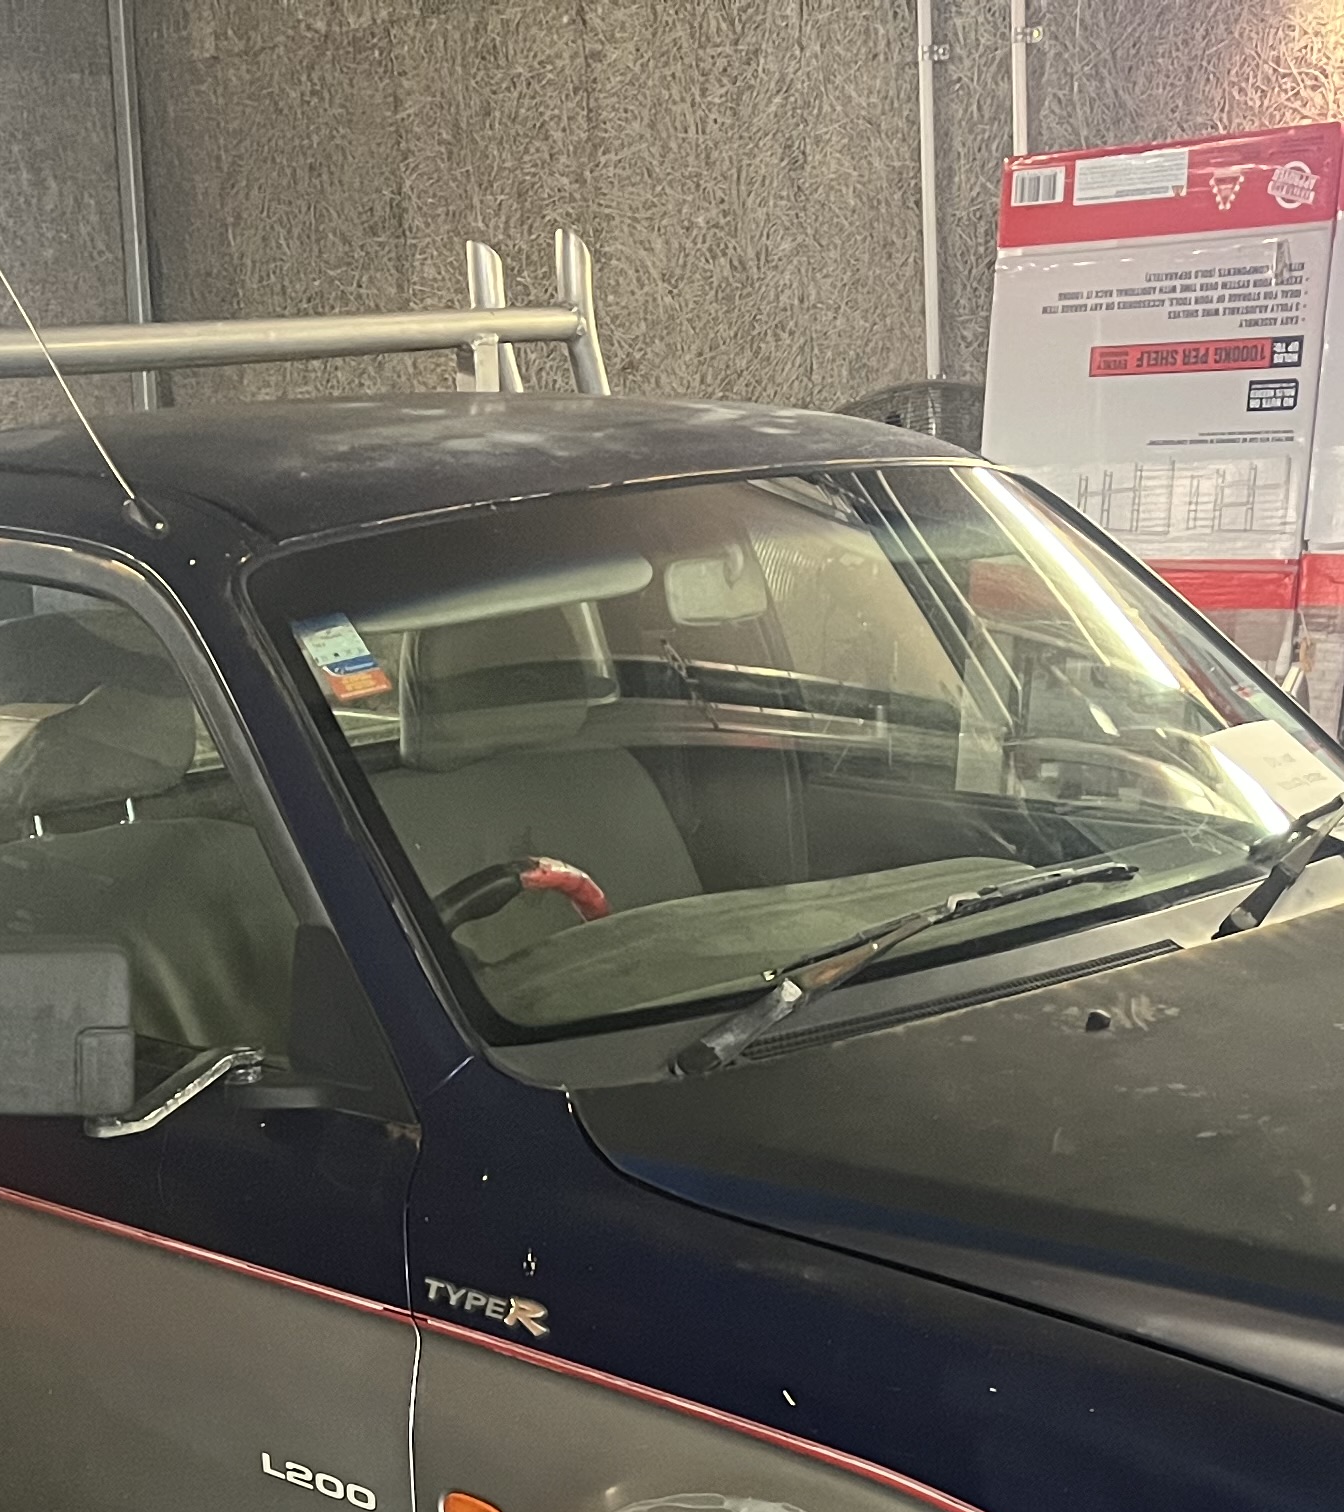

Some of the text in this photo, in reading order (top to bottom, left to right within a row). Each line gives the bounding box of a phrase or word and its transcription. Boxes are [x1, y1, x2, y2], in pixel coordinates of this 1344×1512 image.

[1227, 291, 1261, 303] STORAGE
[1262, 290, 1278, 300] FOR
[1222, 303, 1268, 316] ADJUSTABLE
[1270, 302, 1293, 312] FULLY
[1238, 314, 1298, 328] EASY ASSEMBLY
[1134, 344, 1265, 367] 1000KG PER SHELF
[262, 1452, 376, 1511] L200
